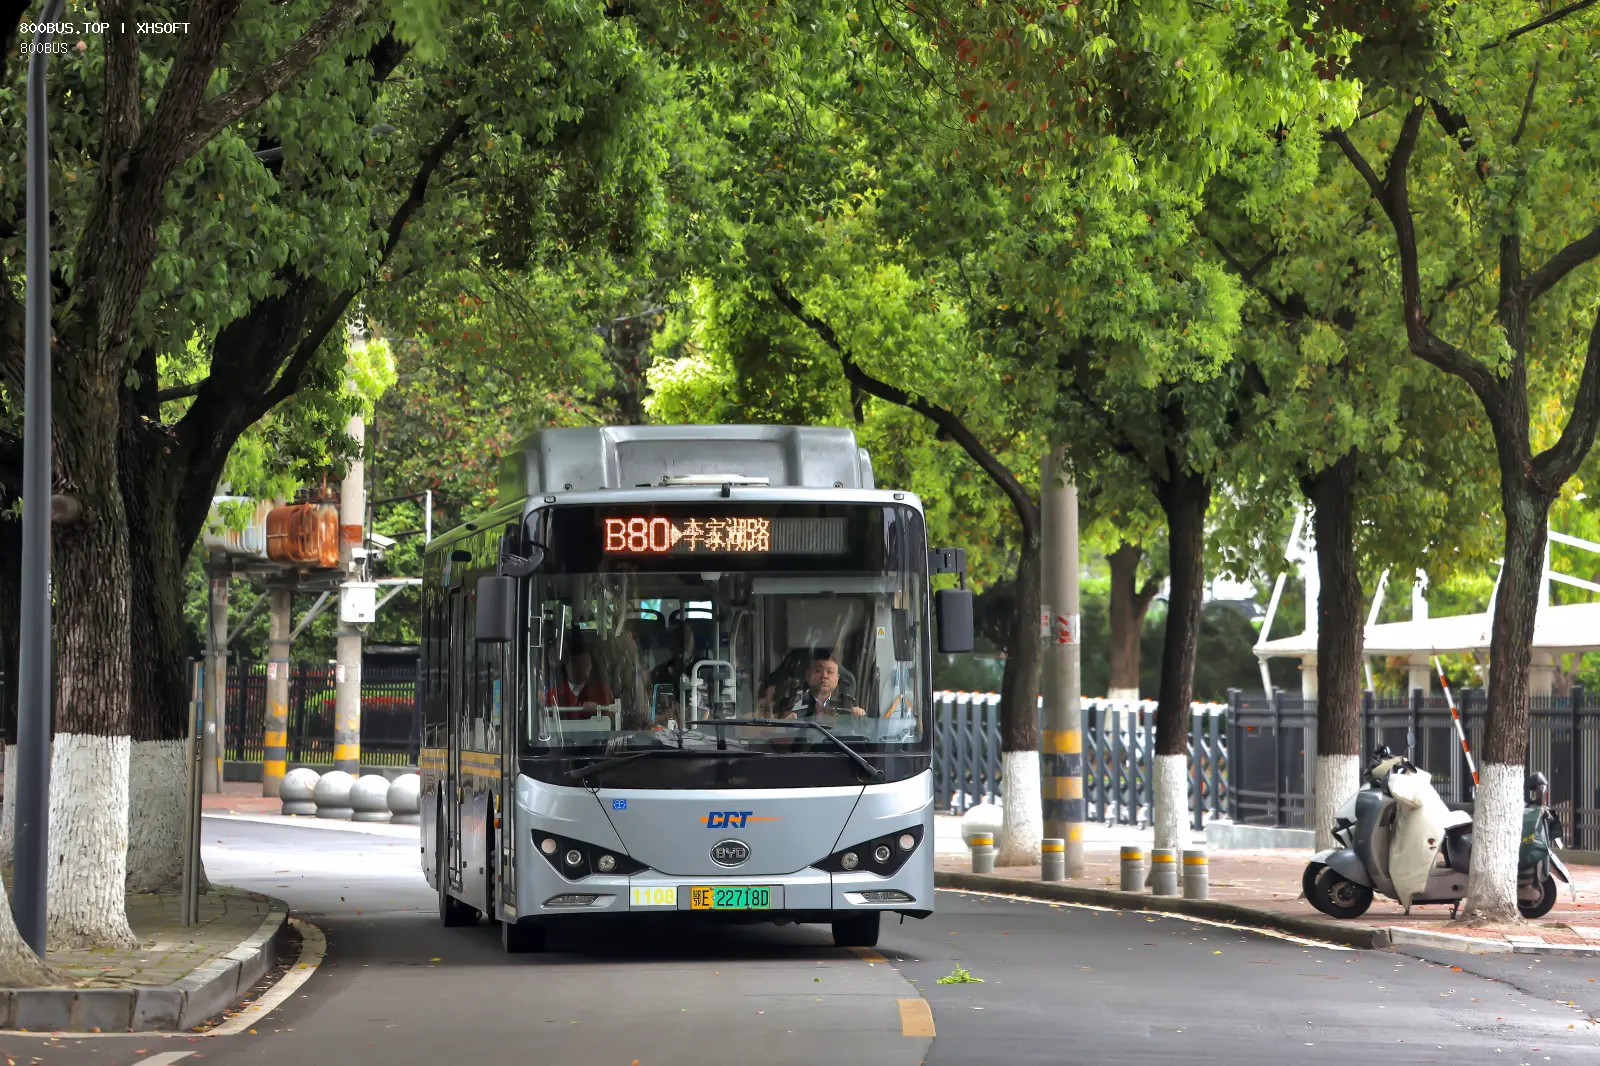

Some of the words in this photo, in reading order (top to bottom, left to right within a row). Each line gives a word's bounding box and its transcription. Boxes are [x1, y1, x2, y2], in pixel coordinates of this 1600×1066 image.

[605, 517, 670, 552] B80
[715, 847, 746, 858] BYD
[633, 888, 675, 904] 1108
